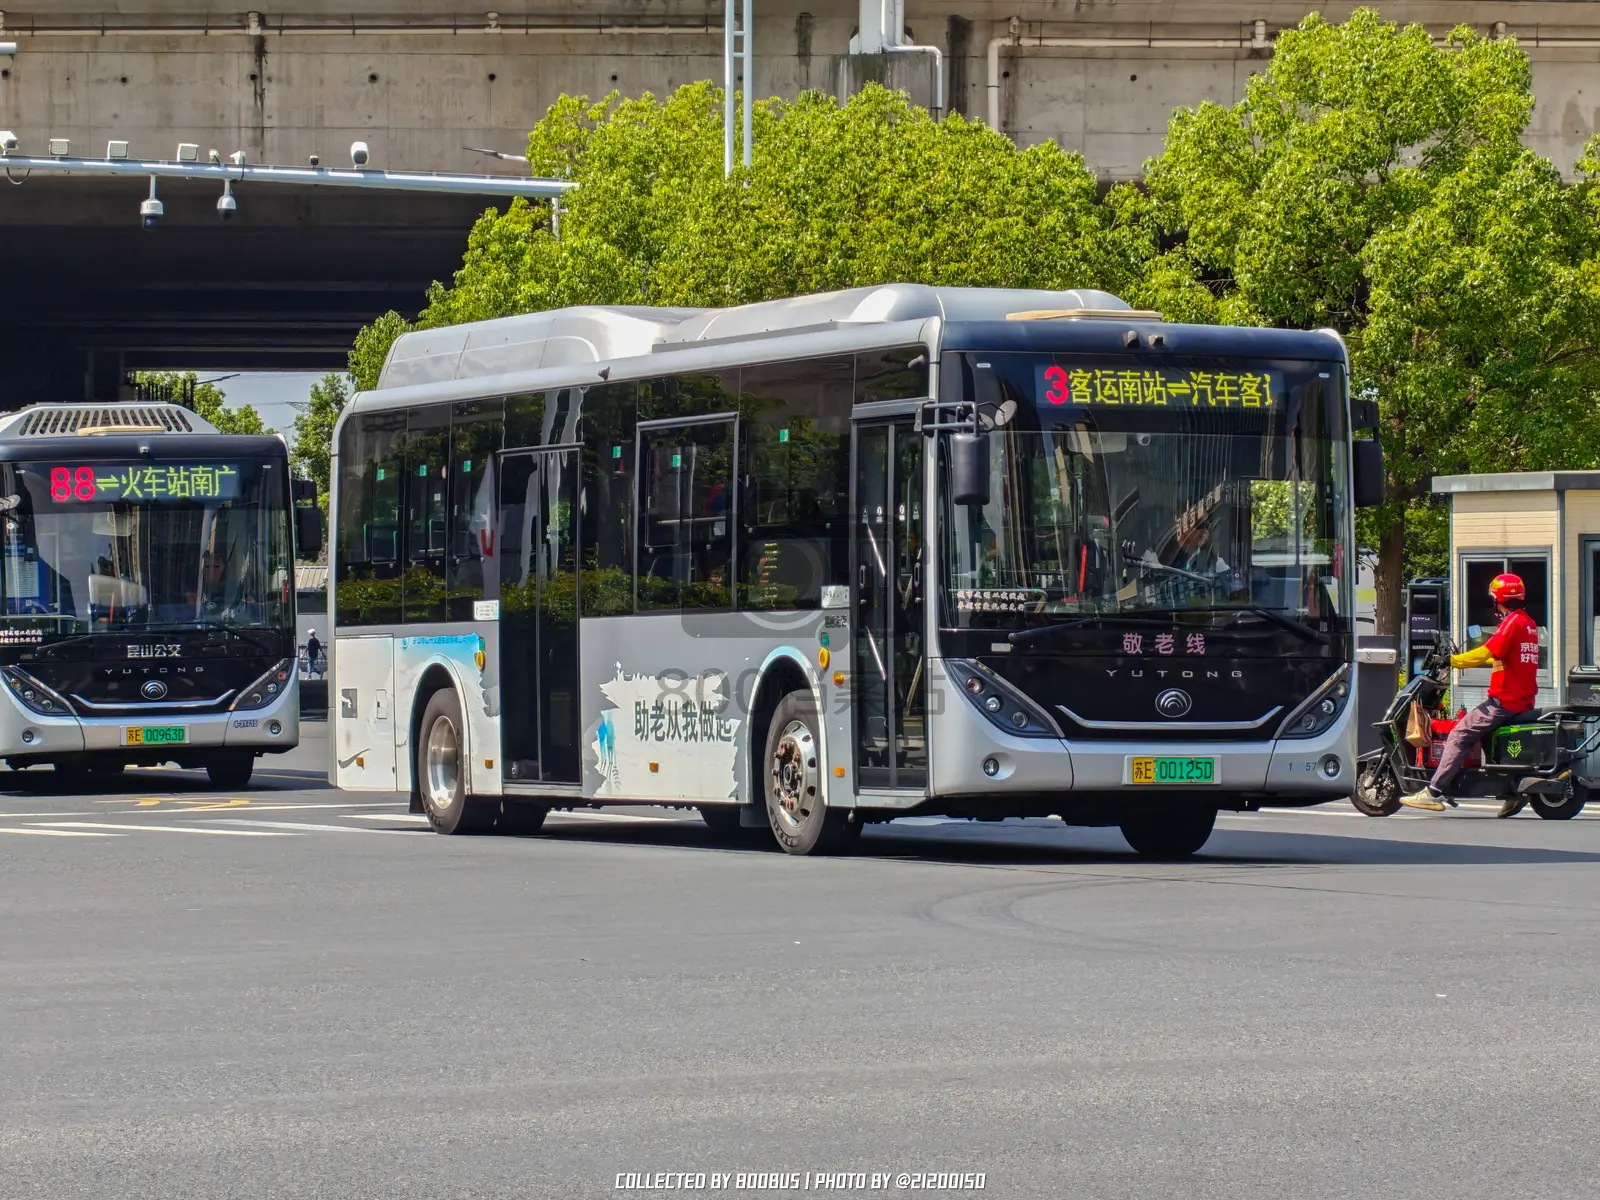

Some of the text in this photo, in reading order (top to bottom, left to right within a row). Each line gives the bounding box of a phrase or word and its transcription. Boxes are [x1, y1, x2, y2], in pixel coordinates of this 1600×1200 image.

[1044, 365, 1069, 405] 3
[1069, 369, 1167, 405] 客运南站
[51, 465, 236, 502] 88 火车站南广
[104, 666, 204, 674] YUTONG
[1105, 669, 1243, 678] YUTONG
